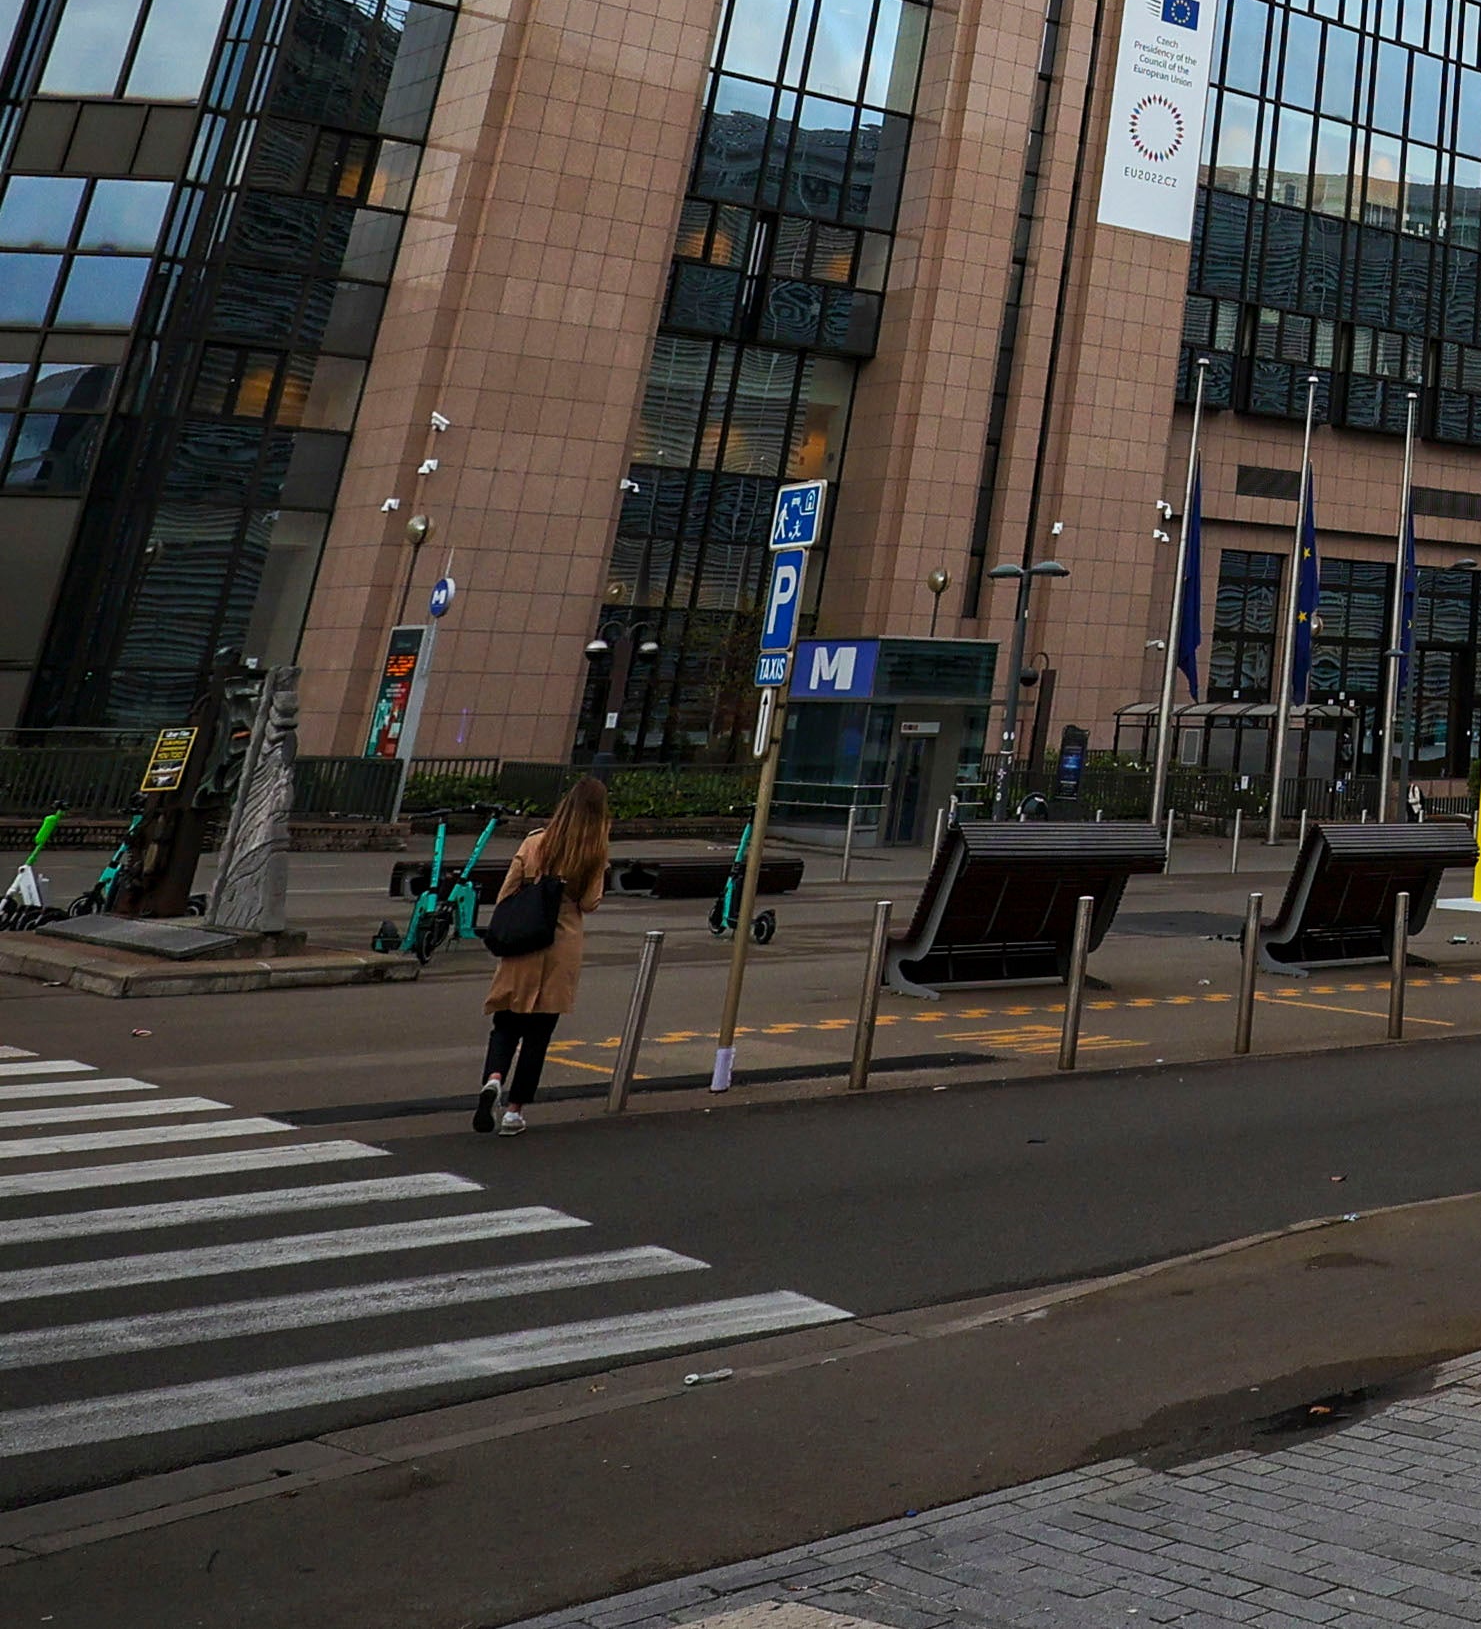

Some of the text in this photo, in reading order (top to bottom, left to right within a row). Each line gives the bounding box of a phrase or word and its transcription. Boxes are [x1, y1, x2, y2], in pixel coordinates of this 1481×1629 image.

[1134, 40, 1197, 66] Presidency of the
[1156, 35, 1179, 49] Czech
[1133, 64, 1193, 88] European Union
[1139, 54, 1190, 76] Council of the
[1124, 166, 1178, 188] EU2022.CZ
[431, 590, 447, 605] M
[766, 565, 797, 635] P
[759, 658, 785, 680] TAXIS
[809, 646, 857, 690] M
